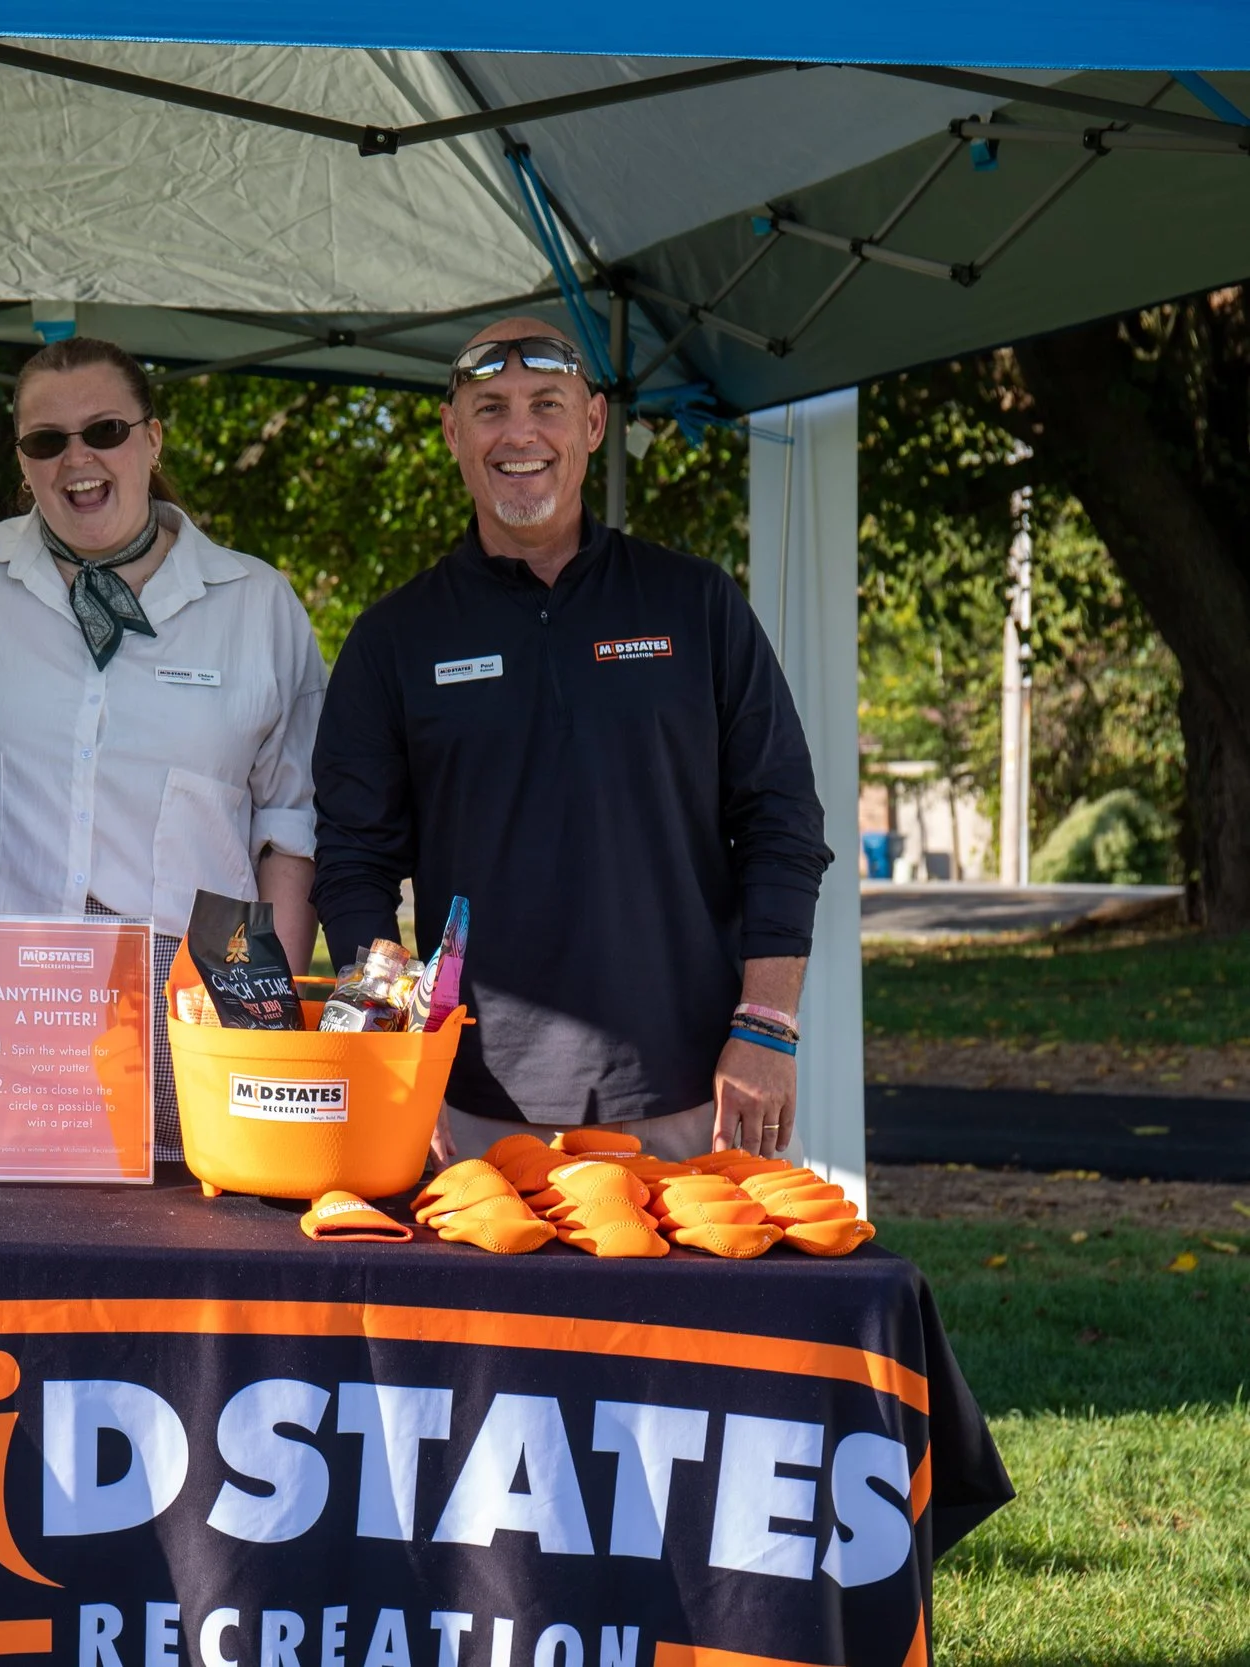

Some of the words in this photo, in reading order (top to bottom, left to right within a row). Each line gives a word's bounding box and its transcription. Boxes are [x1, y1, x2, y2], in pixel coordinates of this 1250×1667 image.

[618, 652, 654, 660] RECREATION
[90, 989, 120, 1004] BUT
[261, 1000, 284, 1014] BBQ
[15, 1010, 27, 1025] A
[34, 1011, 97, 1026] PUTTER!
[11, 1044, 35, 1058] Spin
[39, 1044, 55, 1056] the
[59, 1044, 91, 1056] wheel
[94, 1045, 110, 1057] for
[31, 1064, 56, 1075] your
[59, 1063, 91, 1075] putter
[11, 1083, 32, 1095] Get
[35, 1086, 48, 1095] as
[51, 1084, 79, 1095] close
[82, 1085, 93, 1096] to
[96, 1084, 113, 1096] the
[8, 1099, 38, 1111] circle
[42, 1103, 54, 1111] as
[58, 1101, 101, 1114] possible
[105, 1102, 116, 1112] to
[263, 1105, 316, 1114] RECREATION
[27, 1118, 46, 1128] win
[50, 1120, 57, 1128] a
[61, 1118, 93, 1130] prize!
[79, 1601, 640, 1667] RECREATION
